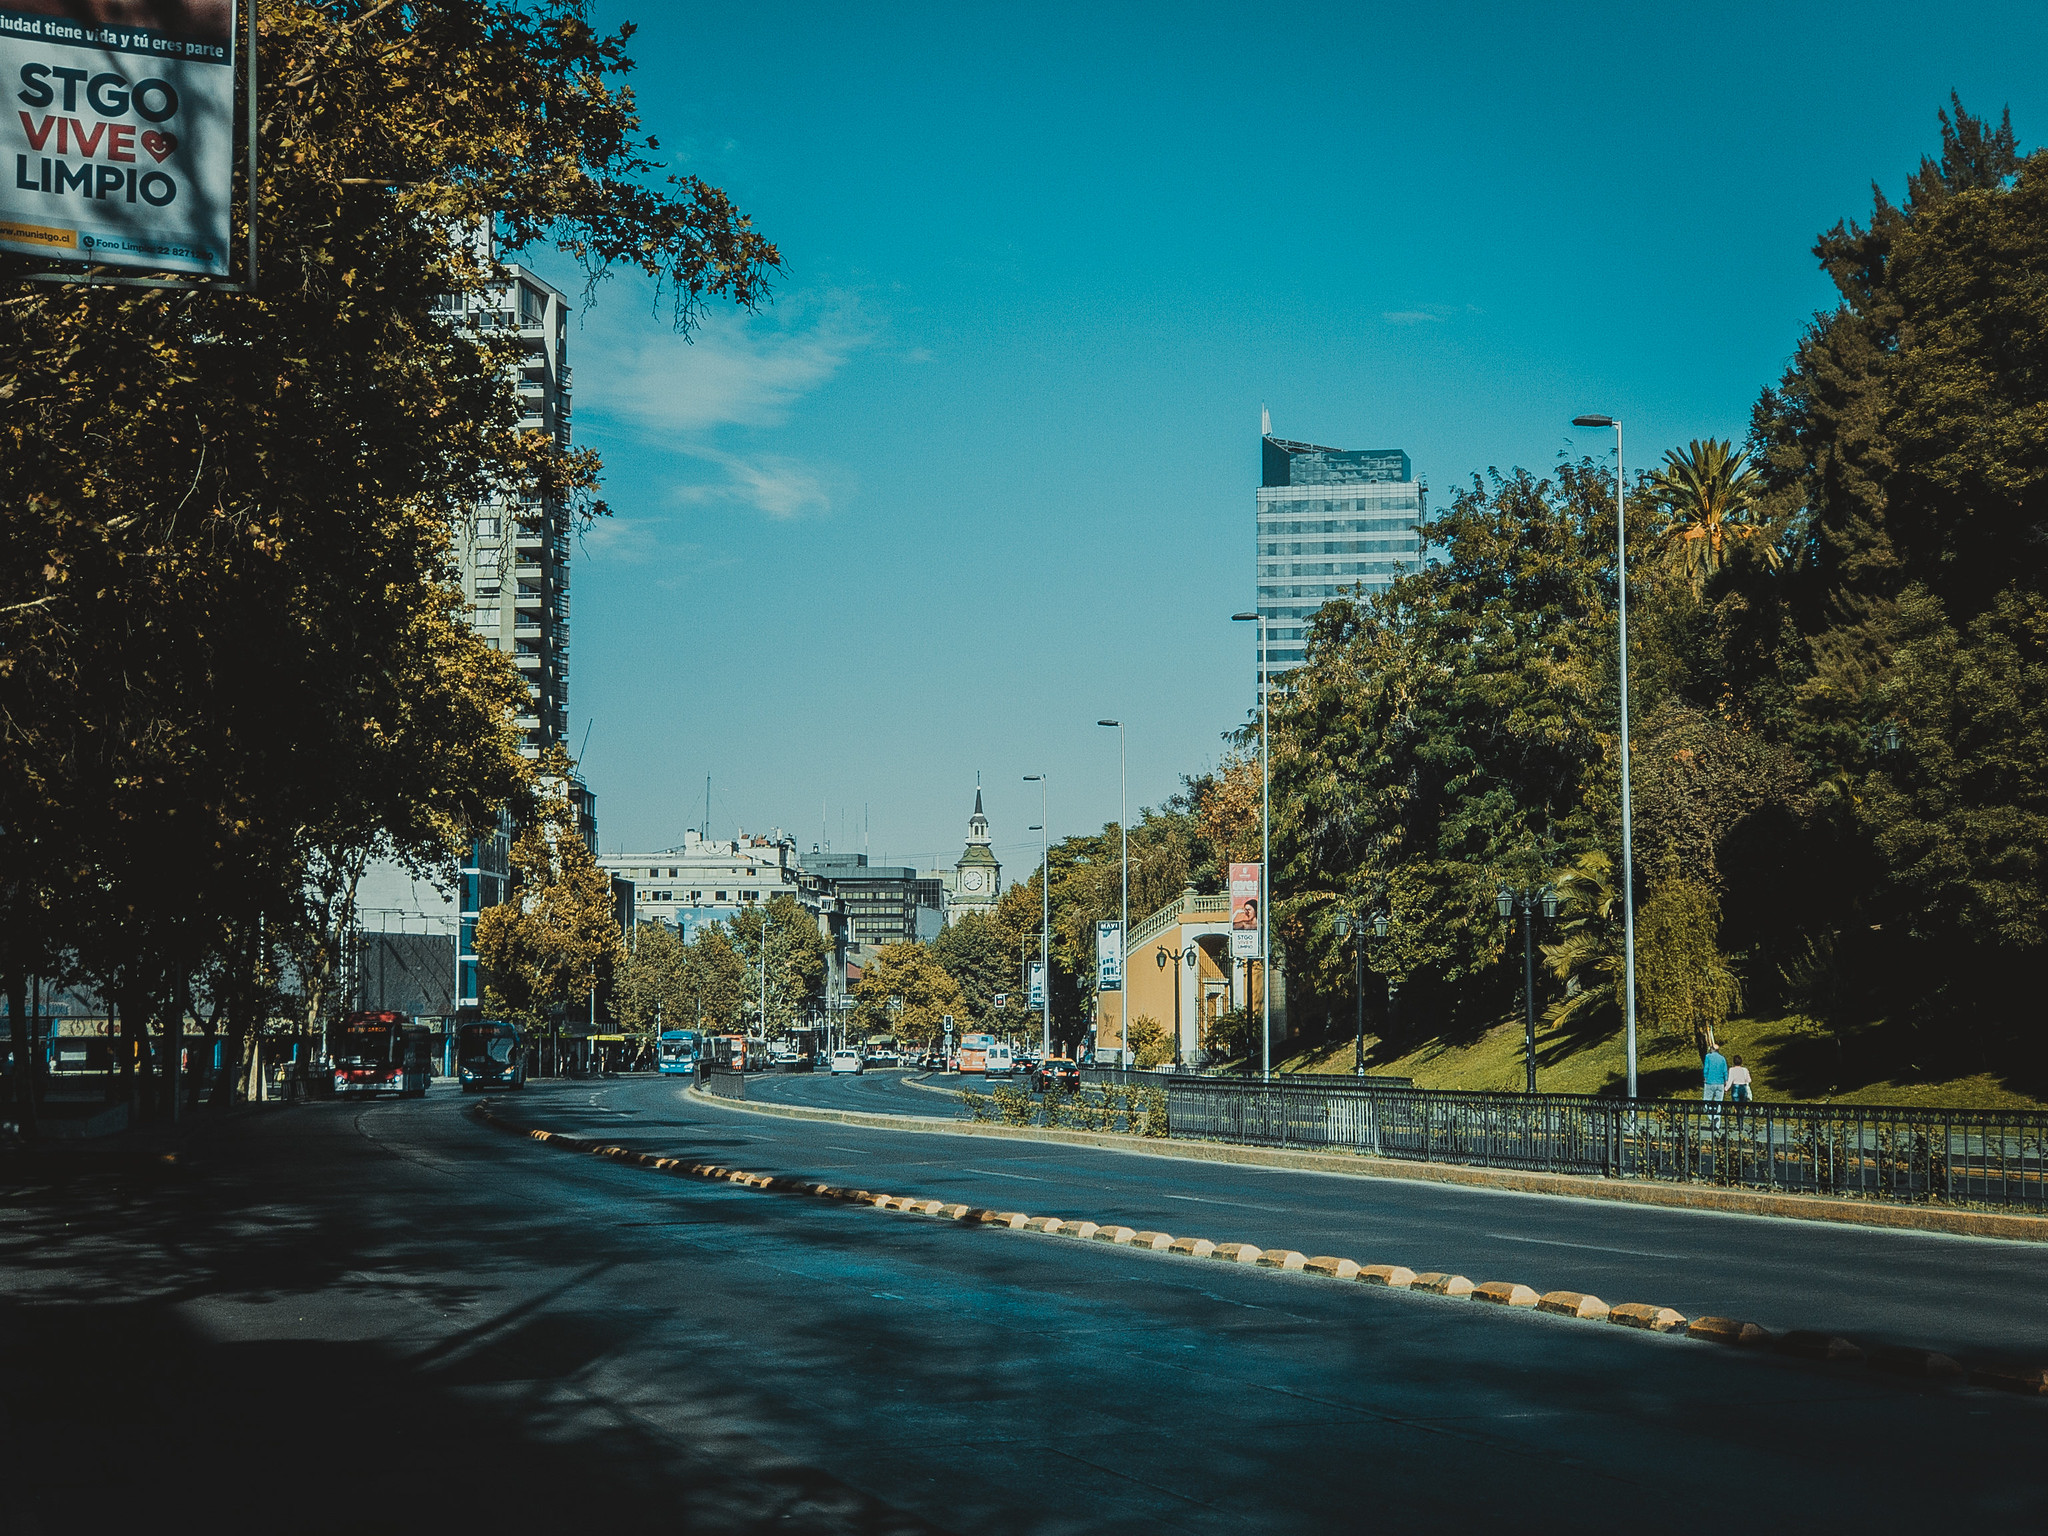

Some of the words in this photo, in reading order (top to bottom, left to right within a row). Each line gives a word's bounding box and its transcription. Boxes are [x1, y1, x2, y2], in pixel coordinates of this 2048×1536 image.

[0, 14, 41, 34] iudad
[44, 22, 82, 41] tiene
[85, 28, 117, 45] vida
[120, 35, 130, 48] y
[133, 34, 149, 49] tú
[152, 38, 182, 52] eres
[185, 42, 224, 58] parte
[18, 62, 179, 123] STGO
[18, 111, 137, 163] VIVE
[16, 154, 177, 207] LIMPIO
[0, 228, 70, 243] ww.munistgo.cl
[96, 239, 119, 249] Fono
[157, 246, 170, 255] 22
